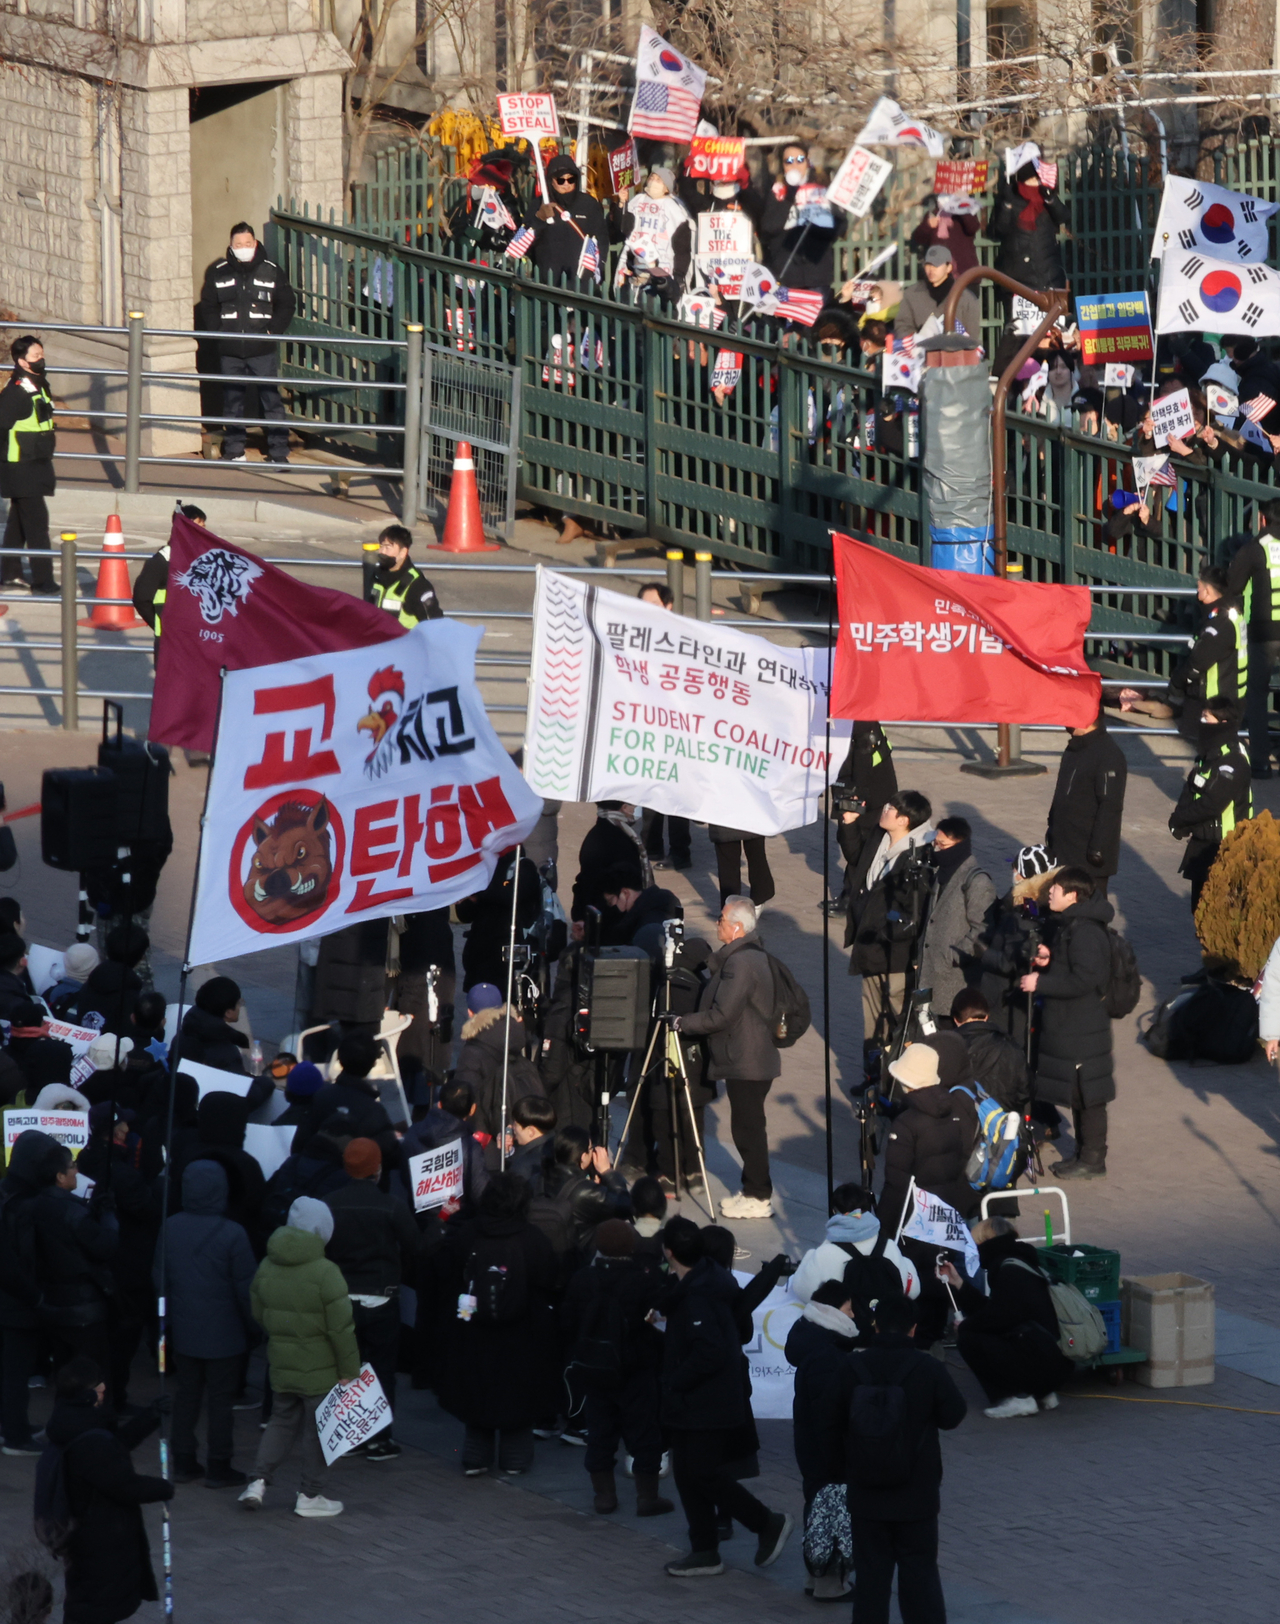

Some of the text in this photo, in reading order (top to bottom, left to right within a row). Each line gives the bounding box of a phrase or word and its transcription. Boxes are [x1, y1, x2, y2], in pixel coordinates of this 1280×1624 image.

[508, 97, 543, 109] STOP
[507, 116, 551, 129] STEAL
[705, 140, 742, 154] CHINA
[693, 154, 739, 176] OUT!
[709, 217, 737, 229] STOP
[713, 229, 732, 240] THE
[708, 240, 738, 252] STEAL
[710, 258, 750, 266] FREEDOM
[1151, 402, 1180, 422] 탄핵무효
[1154, 413, 1192, 436] 대통령 복귀
[199, 629, 225, 643] 1905
[606, 622, 747, 675] 팔레스타인과
[614, 654, 751, 706] 학생 공동행동
[243, 673, 341, 791] 교
[612, 700, 833, 772] STUDENT COALITION
[609, 726, 770, 779] FOR PALESTINE
[606, 752, 679, 783] KOREA
[344, 776, 518, 915] 탄핵
[8, 1117, 38, 1126] 민족고대
